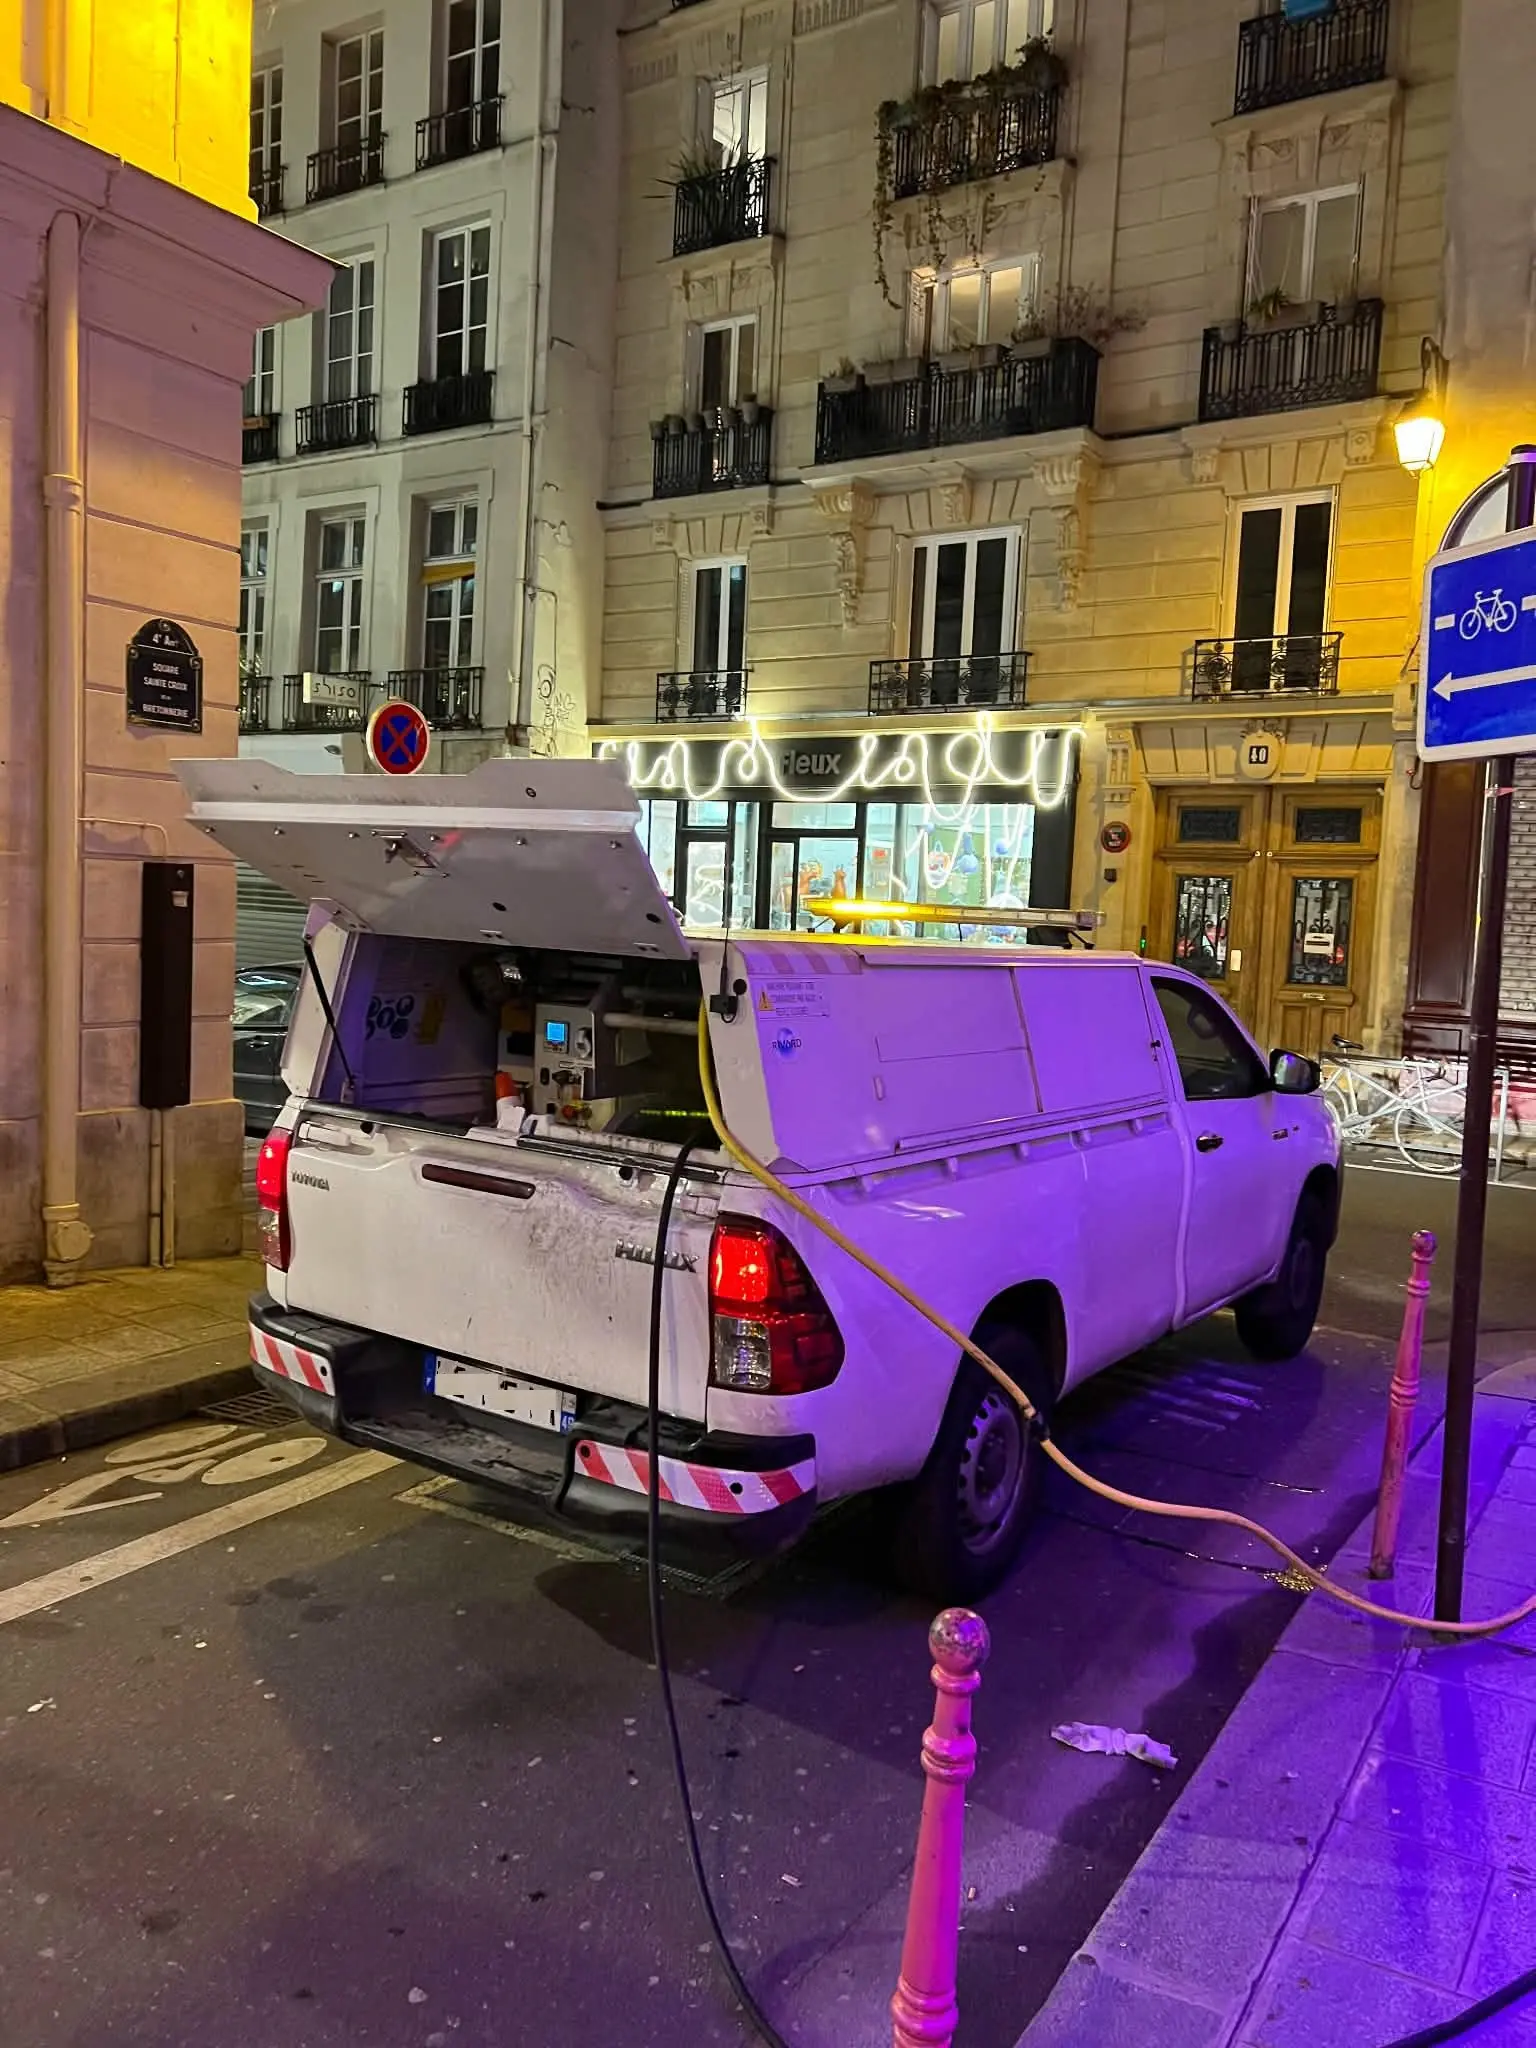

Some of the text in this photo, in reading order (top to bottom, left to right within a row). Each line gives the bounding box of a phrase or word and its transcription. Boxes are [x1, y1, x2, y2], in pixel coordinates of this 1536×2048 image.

[152, 662, 180, 675] SQUARE
[143, 676, 188, 691] SAINTE CROIX
[1250, 747, 1267, 762] 40
